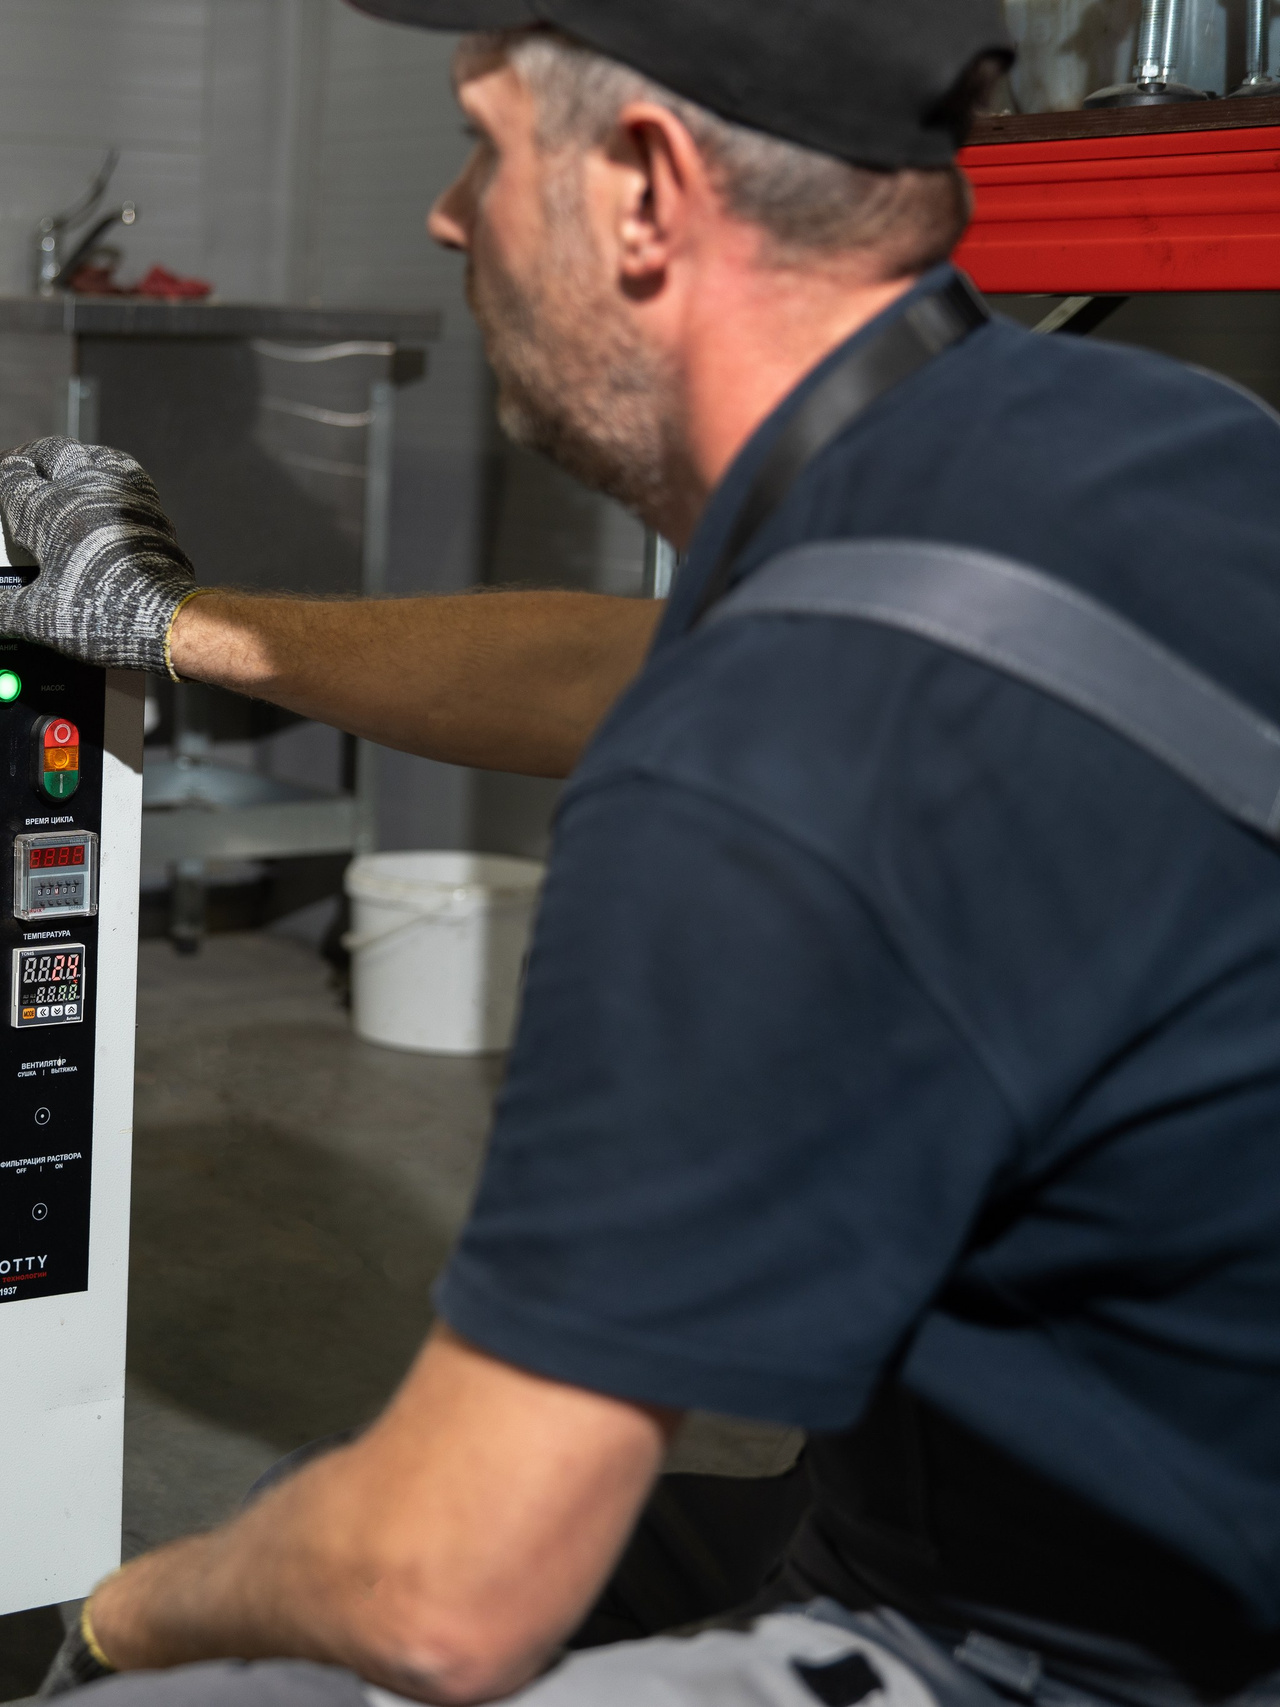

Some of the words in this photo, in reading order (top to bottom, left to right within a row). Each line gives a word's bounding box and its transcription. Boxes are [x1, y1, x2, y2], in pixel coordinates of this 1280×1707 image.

[41, 684, 65, 692] НАСОС
[25, 817, 50, 825] ВРЕМЯ
[50, 816, 74, 824] ЦИКЛА
[23, 930, 71, 940] ТЕМПЕРАТУРА
[24, 1010, 34, 1018] MODE
[21, 1058, 67, 1070] ВЕНТИЛЯТОР
[17, 1070, 37, 1078] СУШКА
[51, 1066, 78, 1075] ВЫТЯЖКА
[0, 1156, 46, 1168] ФИЛЬТРАЦИЯ
[46, 1152, 82, 1163] РАСТВОРА
[2, 1271, 47, 1284] технологии
[0, 1286, 18, 1296] 1937
